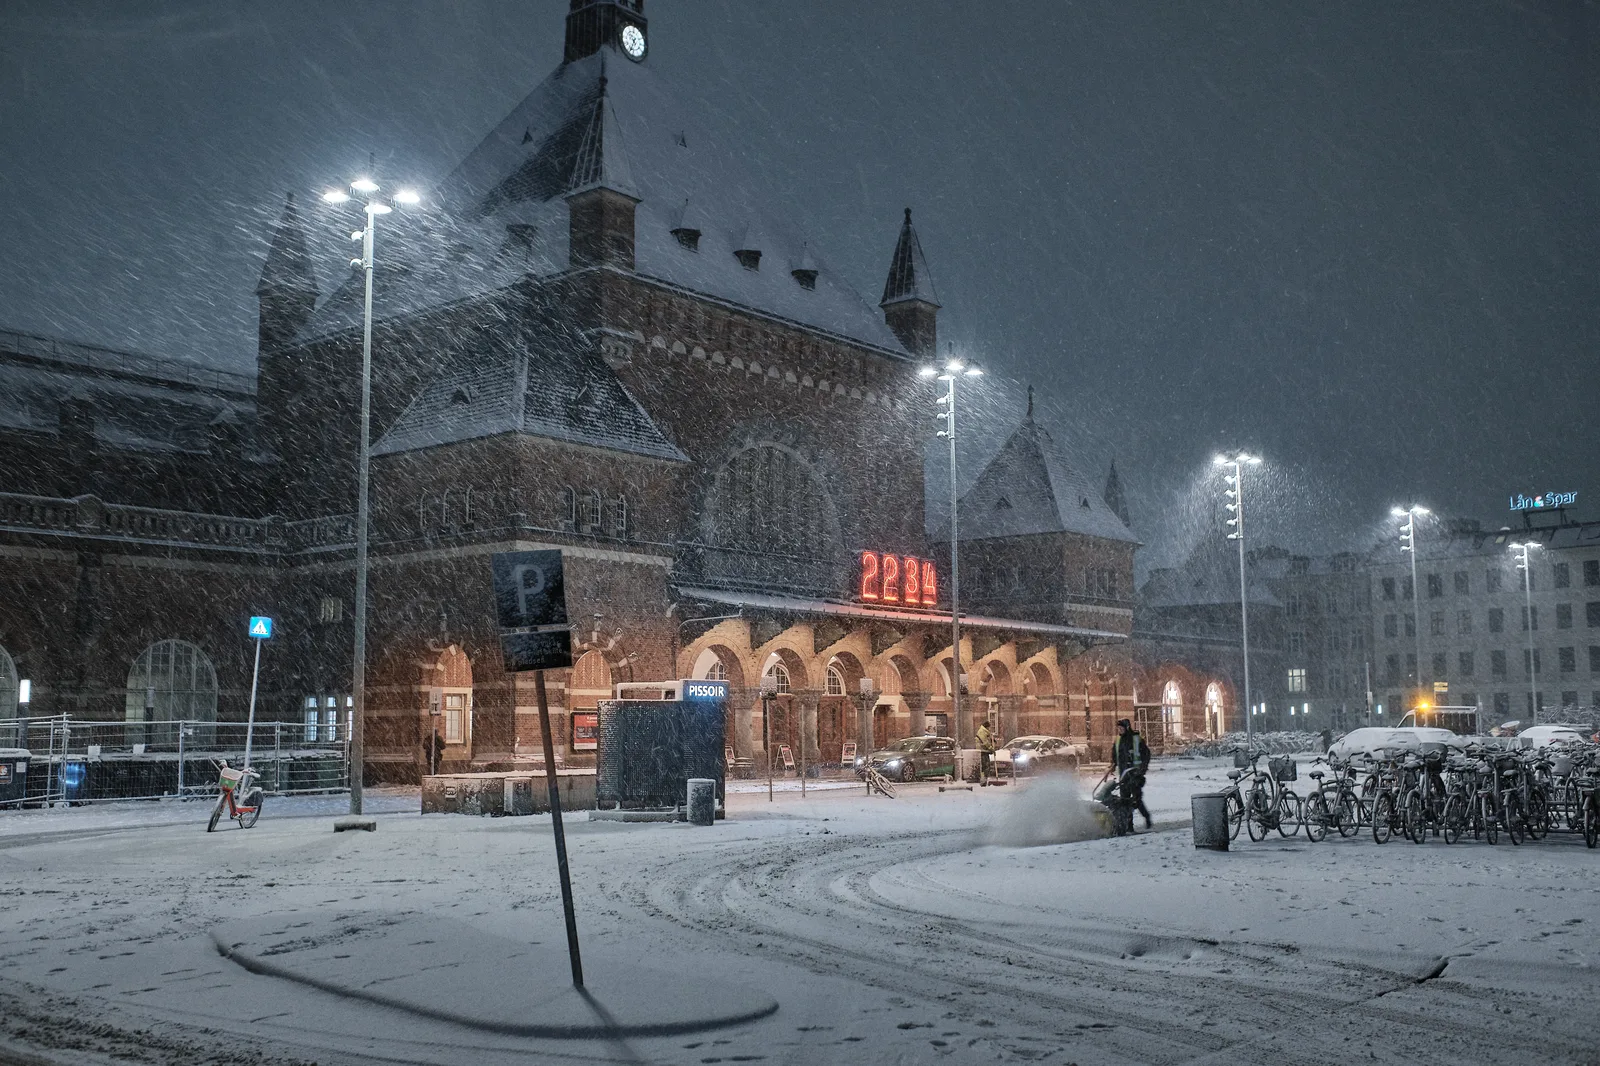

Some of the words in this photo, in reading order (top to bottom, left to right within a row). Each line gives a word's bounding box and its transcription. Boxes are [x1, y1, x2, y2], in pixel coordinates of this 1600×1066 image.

[1509, 494, 1533, 510] Lån
[1545, 491, 1577, 508] Spar
[512, 563, 545, 617] P
[862, 553, 936, 602] 2234
[688, 685, 725, 697] PISSOIR
